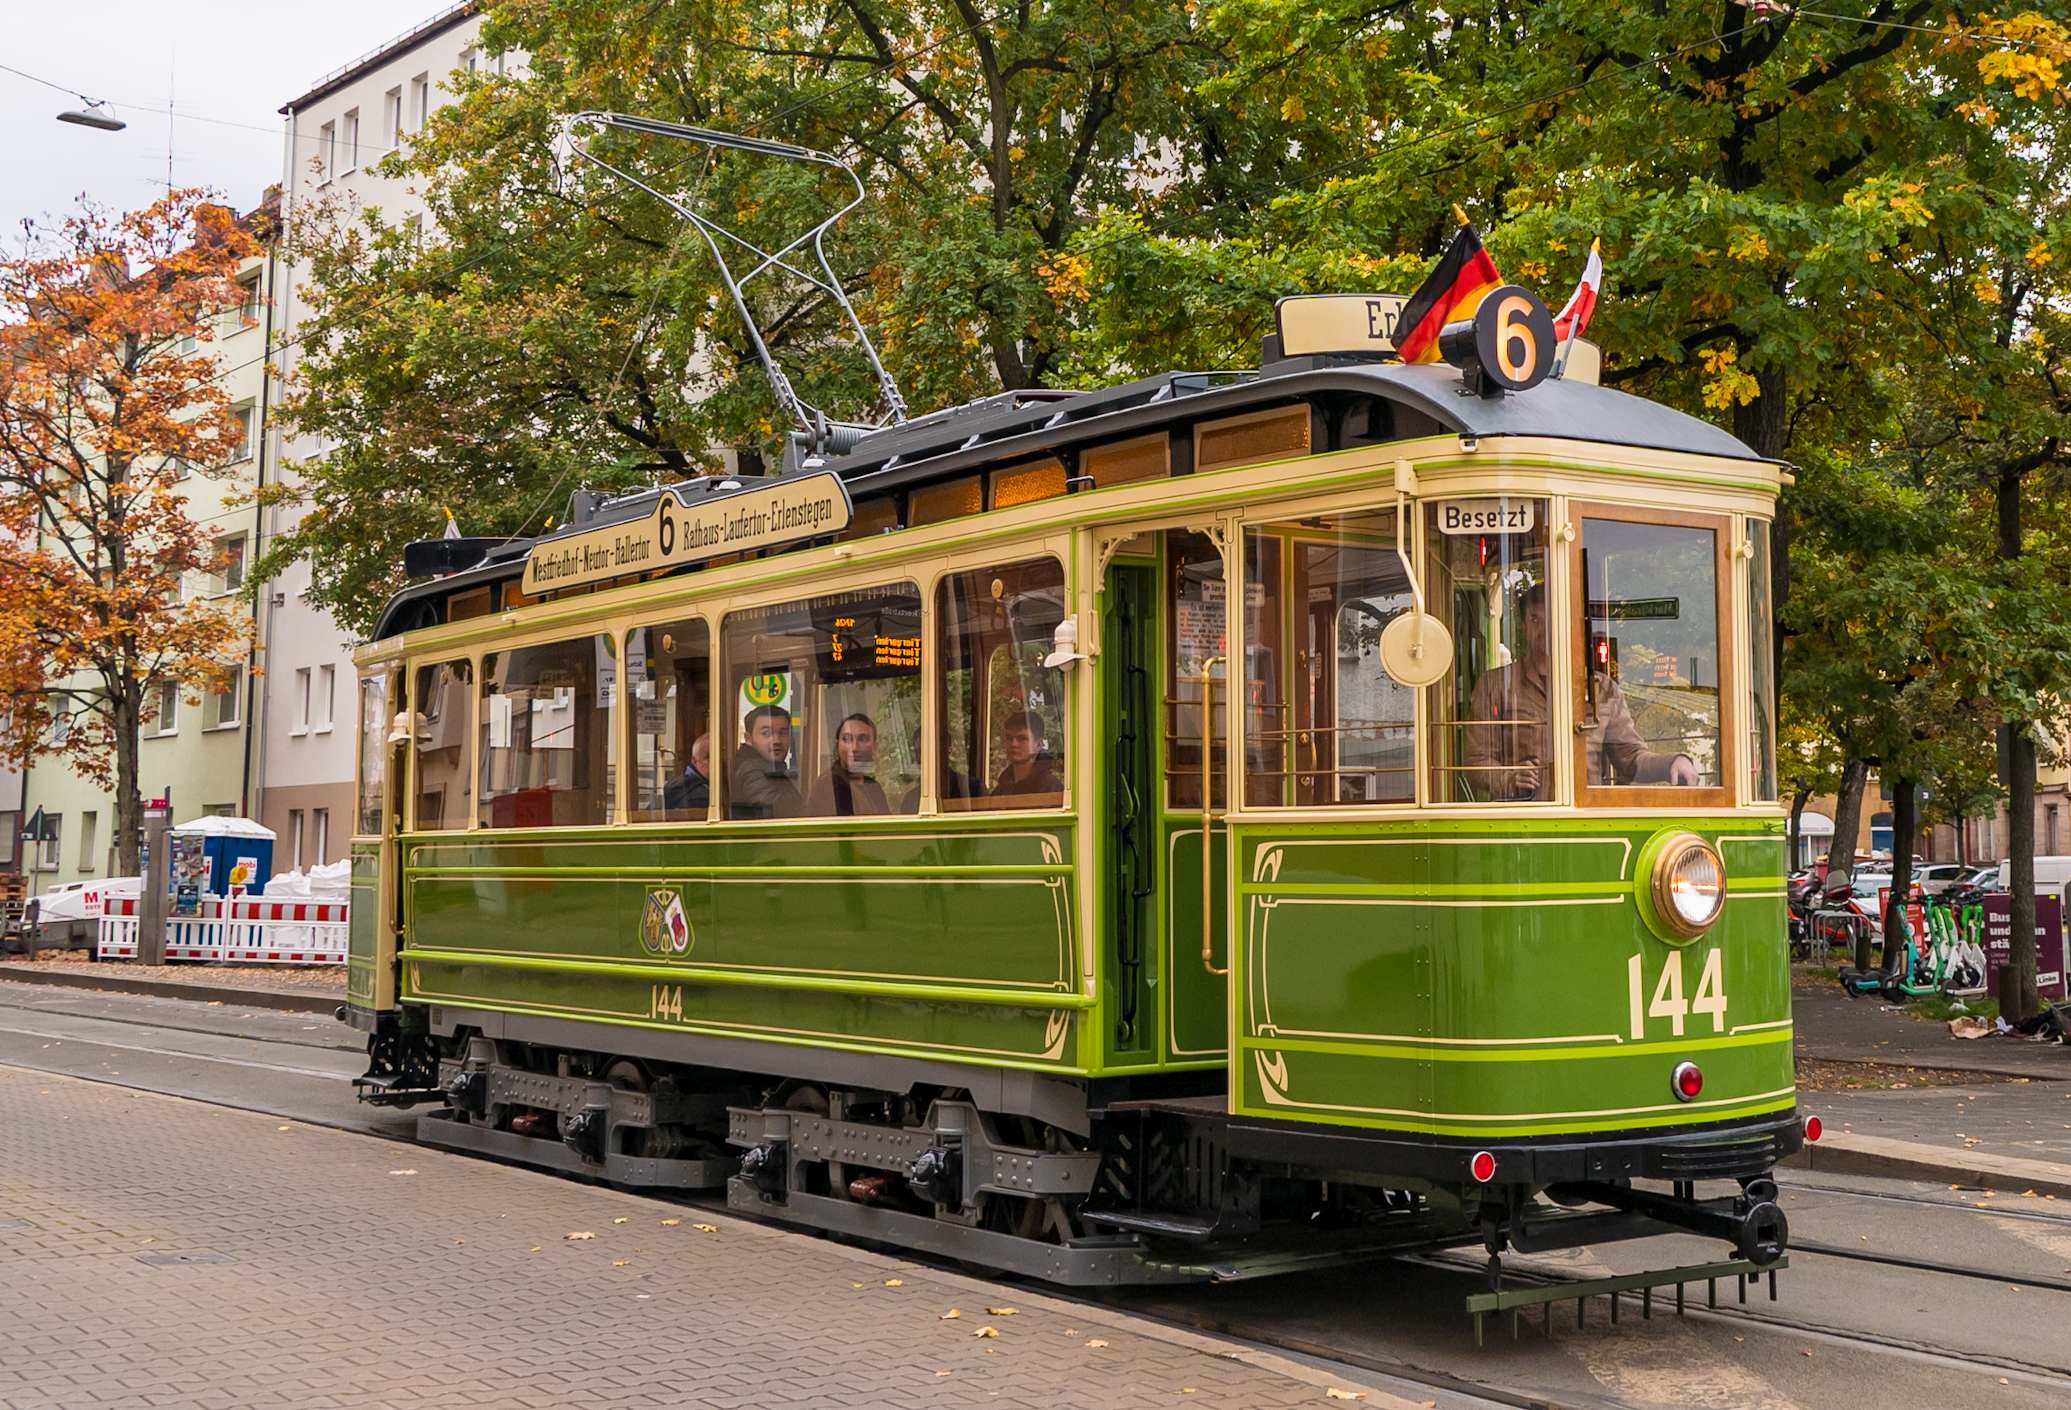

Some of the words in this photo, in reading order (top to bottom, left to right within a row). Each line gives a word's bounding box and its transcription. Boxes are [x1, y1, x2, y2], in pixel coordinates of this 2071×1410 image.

[1494, 296, 1537, 382] 6
[659, 497, 675, 556] 6
[1446, 505, 1527, 528] Besetzt
[651, 984, 683, 1021] 144
[1628, 948, 1728, 1040] 144
